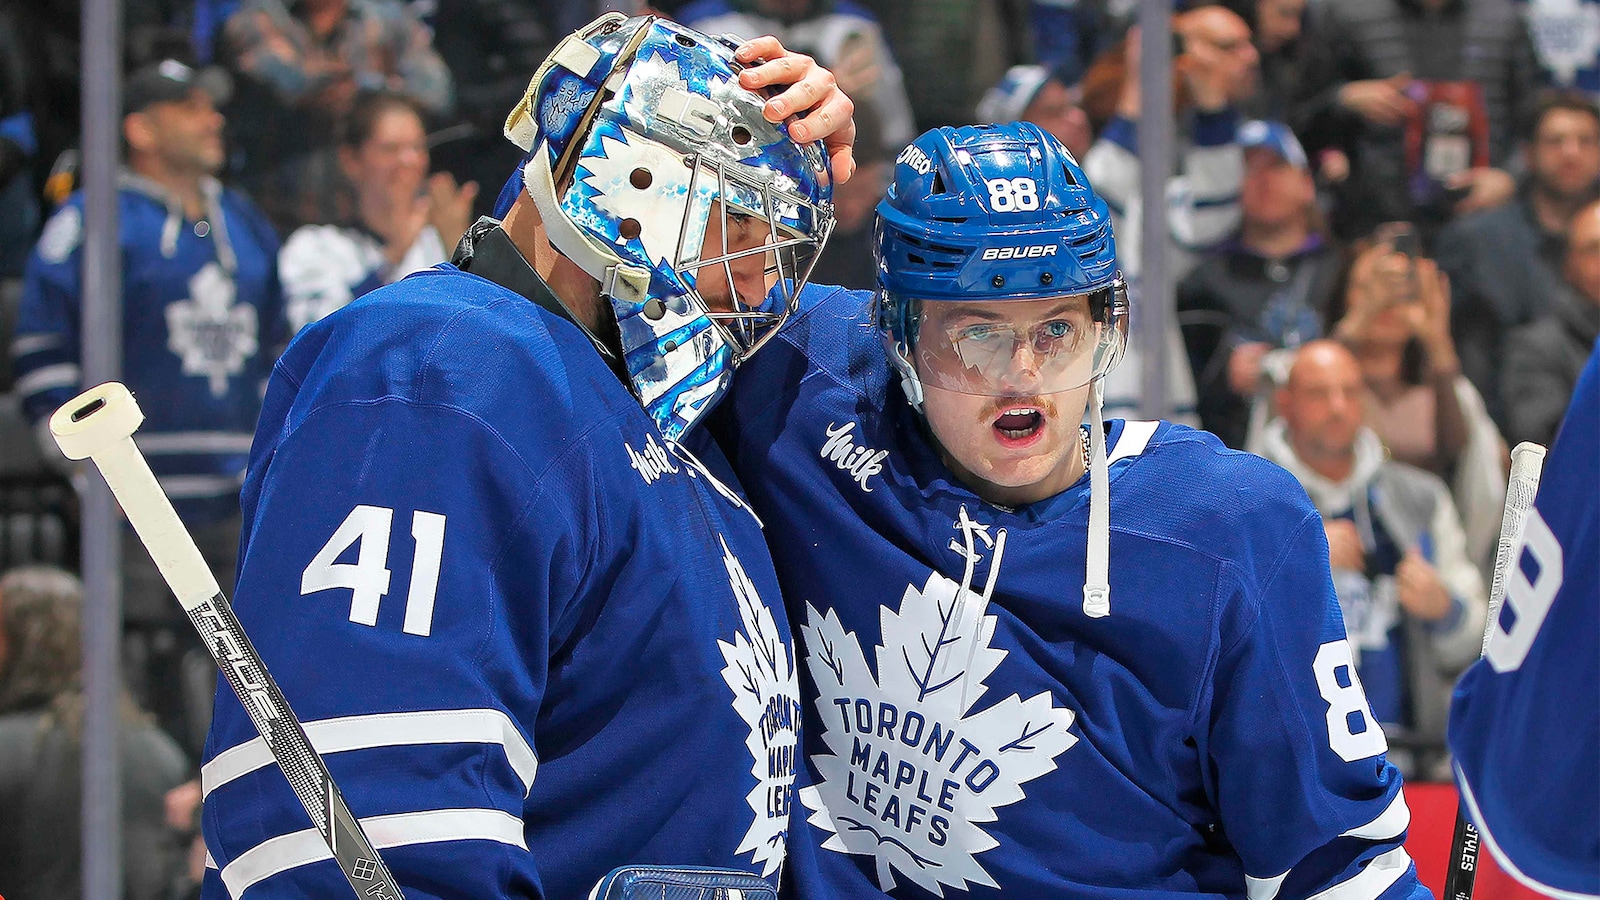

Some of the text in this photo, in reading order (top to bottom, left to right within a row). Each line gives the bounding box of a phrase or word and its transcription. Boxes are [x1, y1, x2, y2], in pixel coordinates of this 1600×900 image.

[895, 143, 931, 175] OREO
[988, 177, 1039, 213] 88
[982, 244, 1058, 261] BAUER
[624, 432, 680, 485] Milk
[820, 420, 889, 493] Milk
[300, 503, 447, 637] 41
[200, 597, 281, 721] TRUE
[758, 693, 802, 750] TORONT
[833, 697, 1001, 794] TORONTO
[768, 744, 797, 779] MAPL
[850, 736, 961, 812] MAPLE
[846, 770, 950, 847] LEAFS
